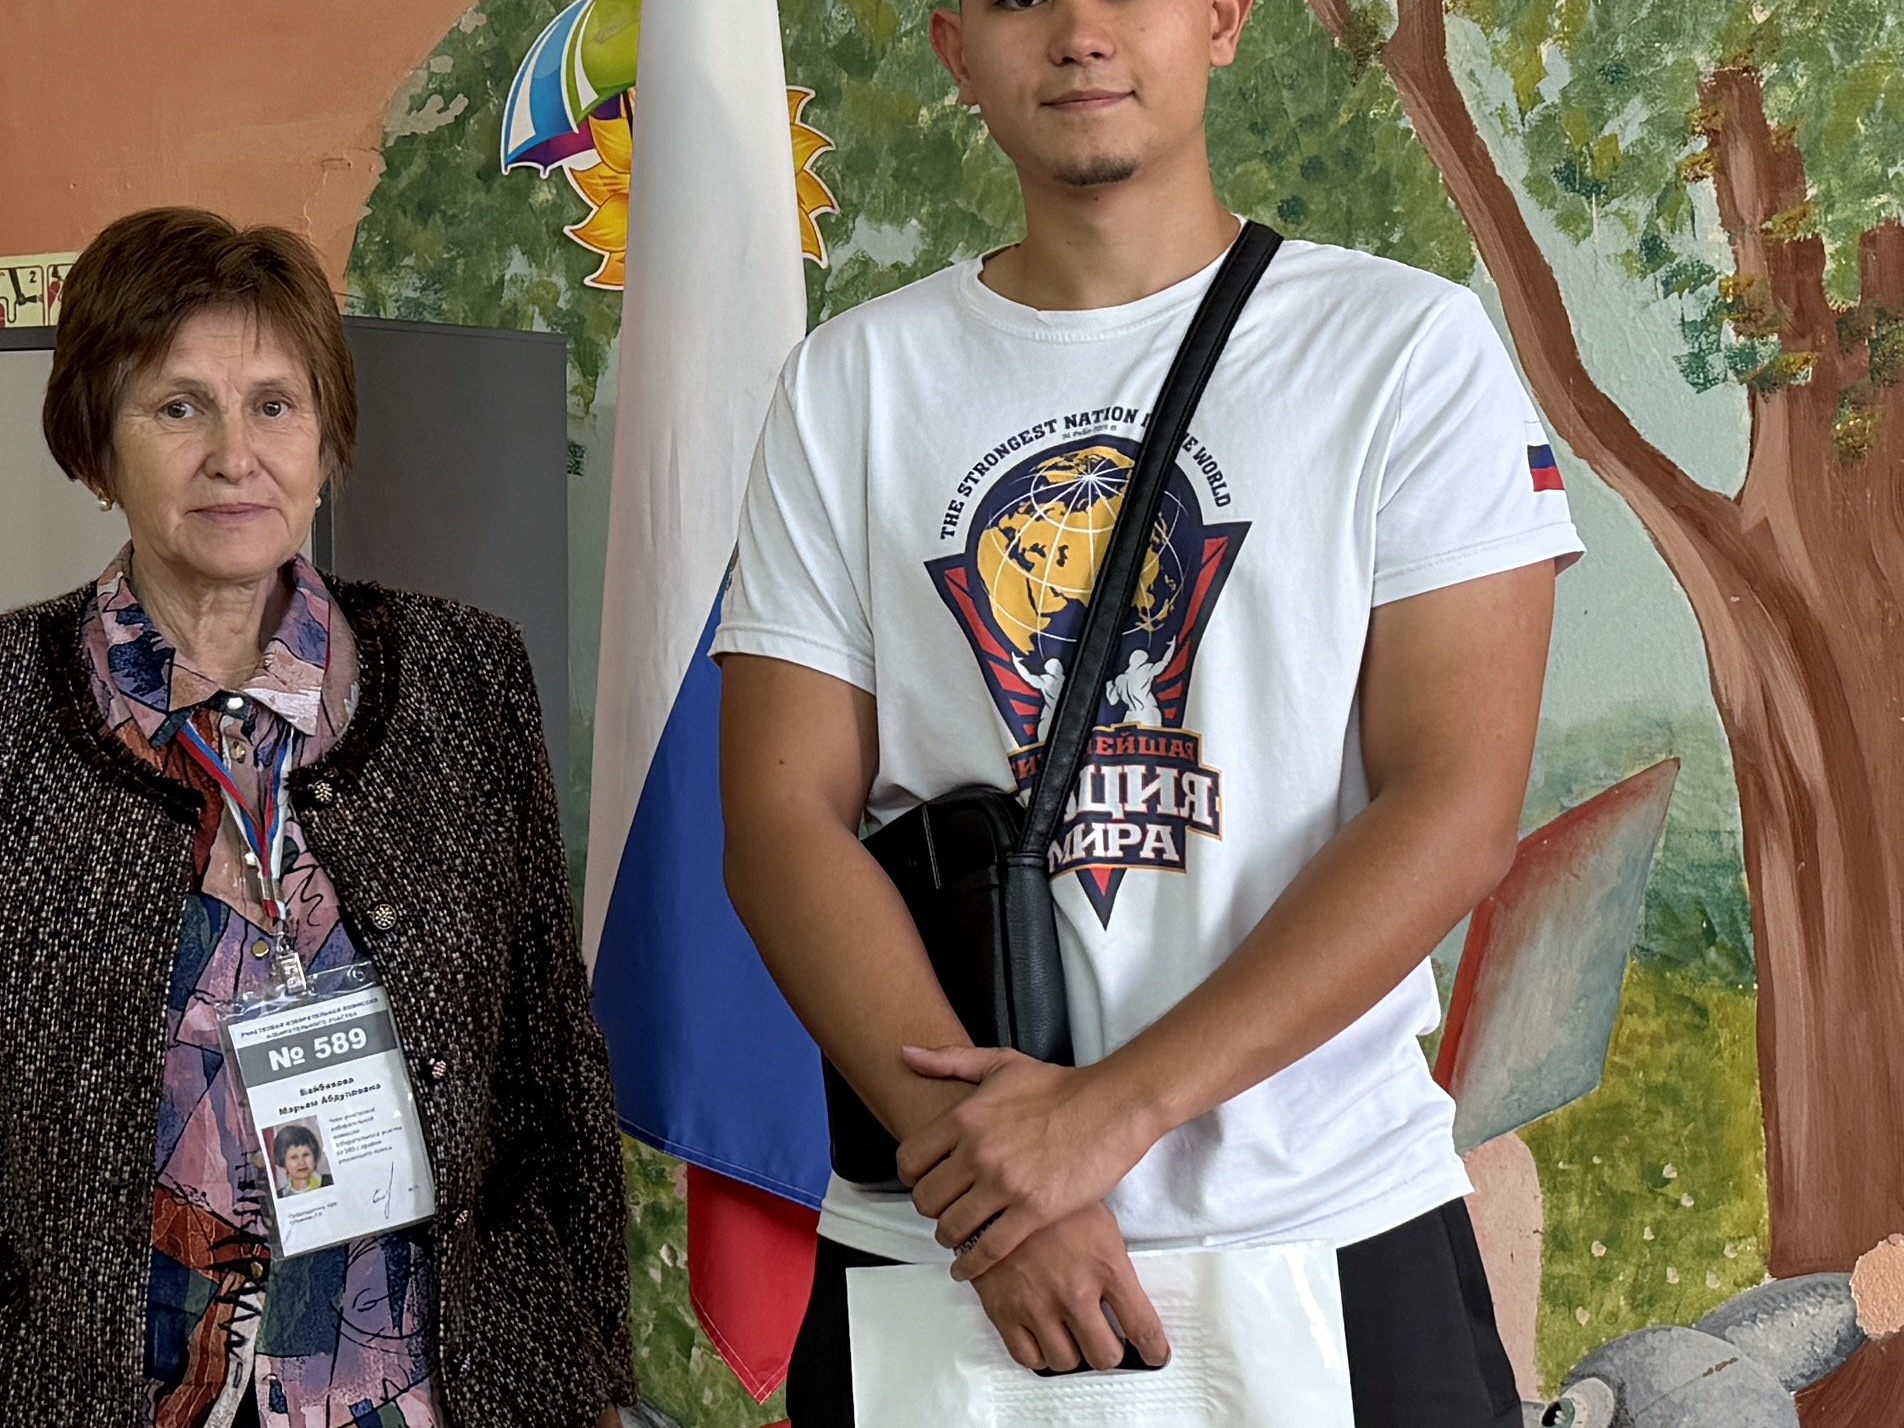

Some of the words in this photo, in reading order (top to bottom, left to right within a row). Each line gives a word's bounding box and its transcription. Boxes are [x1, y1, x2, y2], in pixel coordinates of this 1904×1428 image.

[29, 271, 37, 284] 2
[939, 499, 965, 541] THE
[957, 418, 1057, 498] STRONGEST
[1063, 405, 1139, 430] NATION
[1193, 446, 1232, 508] WORLD
[268, 1047, 306, 1071] №
[313, 1027, 367, 1059] 589
